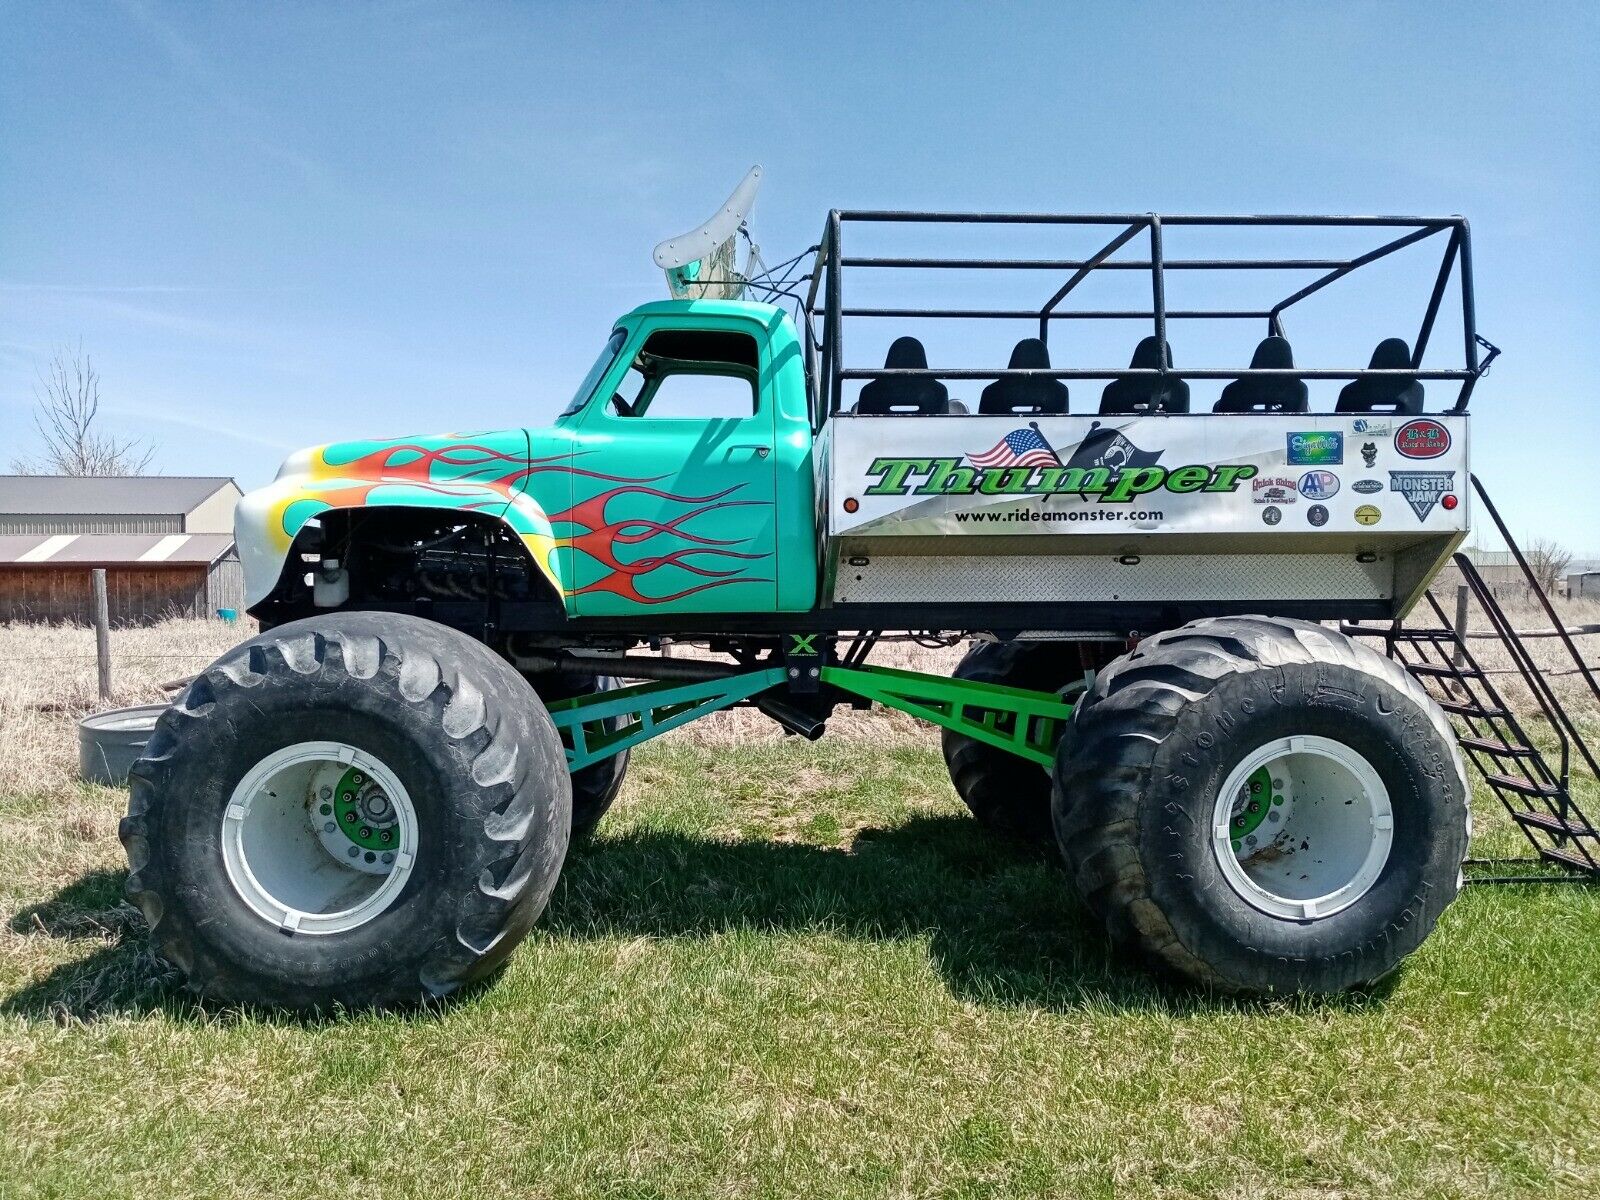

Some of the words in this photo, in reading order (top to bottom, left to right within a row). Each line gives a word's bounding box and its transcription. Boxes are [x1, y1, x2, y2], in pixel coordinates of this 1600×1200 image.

[1406, 428, 1440, 440] B&B
[863, 457, 1258, 503] Thumper
[1252, 477, 1274, 492] Quick
[1275, 477, 1297, 491] Shine
[1391, 478, 1453, 491] MONSTER
[1408, 490, 1438, 503] JAM
[955, 508, 1164, 522] www.rideamonster.com
